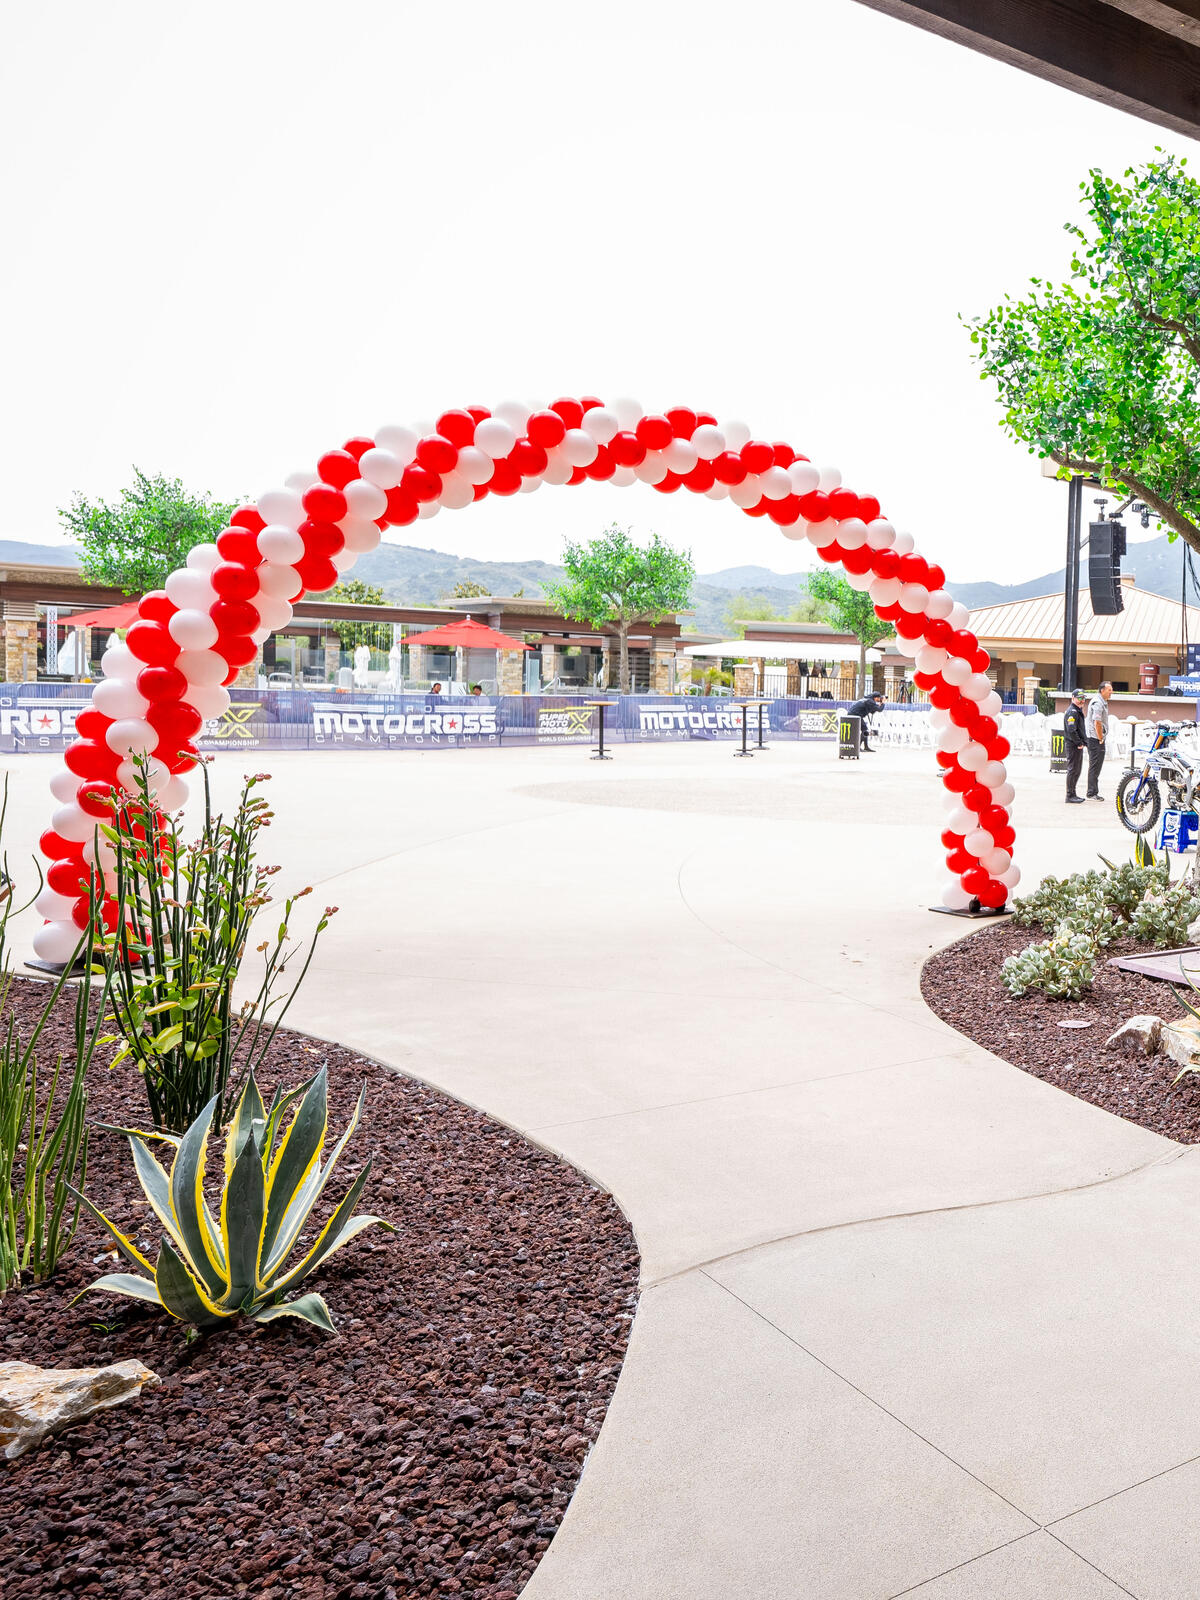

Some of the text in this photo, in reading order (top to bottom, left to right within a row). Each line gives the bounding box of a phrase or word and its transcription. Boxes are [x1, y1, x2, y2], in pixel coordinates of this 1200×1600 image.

[387, 704, 432, 713] PRO
[313, 712, 497, 735] MOTOCROSS
[639, 711, 771, 730] MOTOCROSS
[640, 729, 772, 738] CHAMPIONSHP
[315, 734, 497, 744] CHAMPIONSHIP
